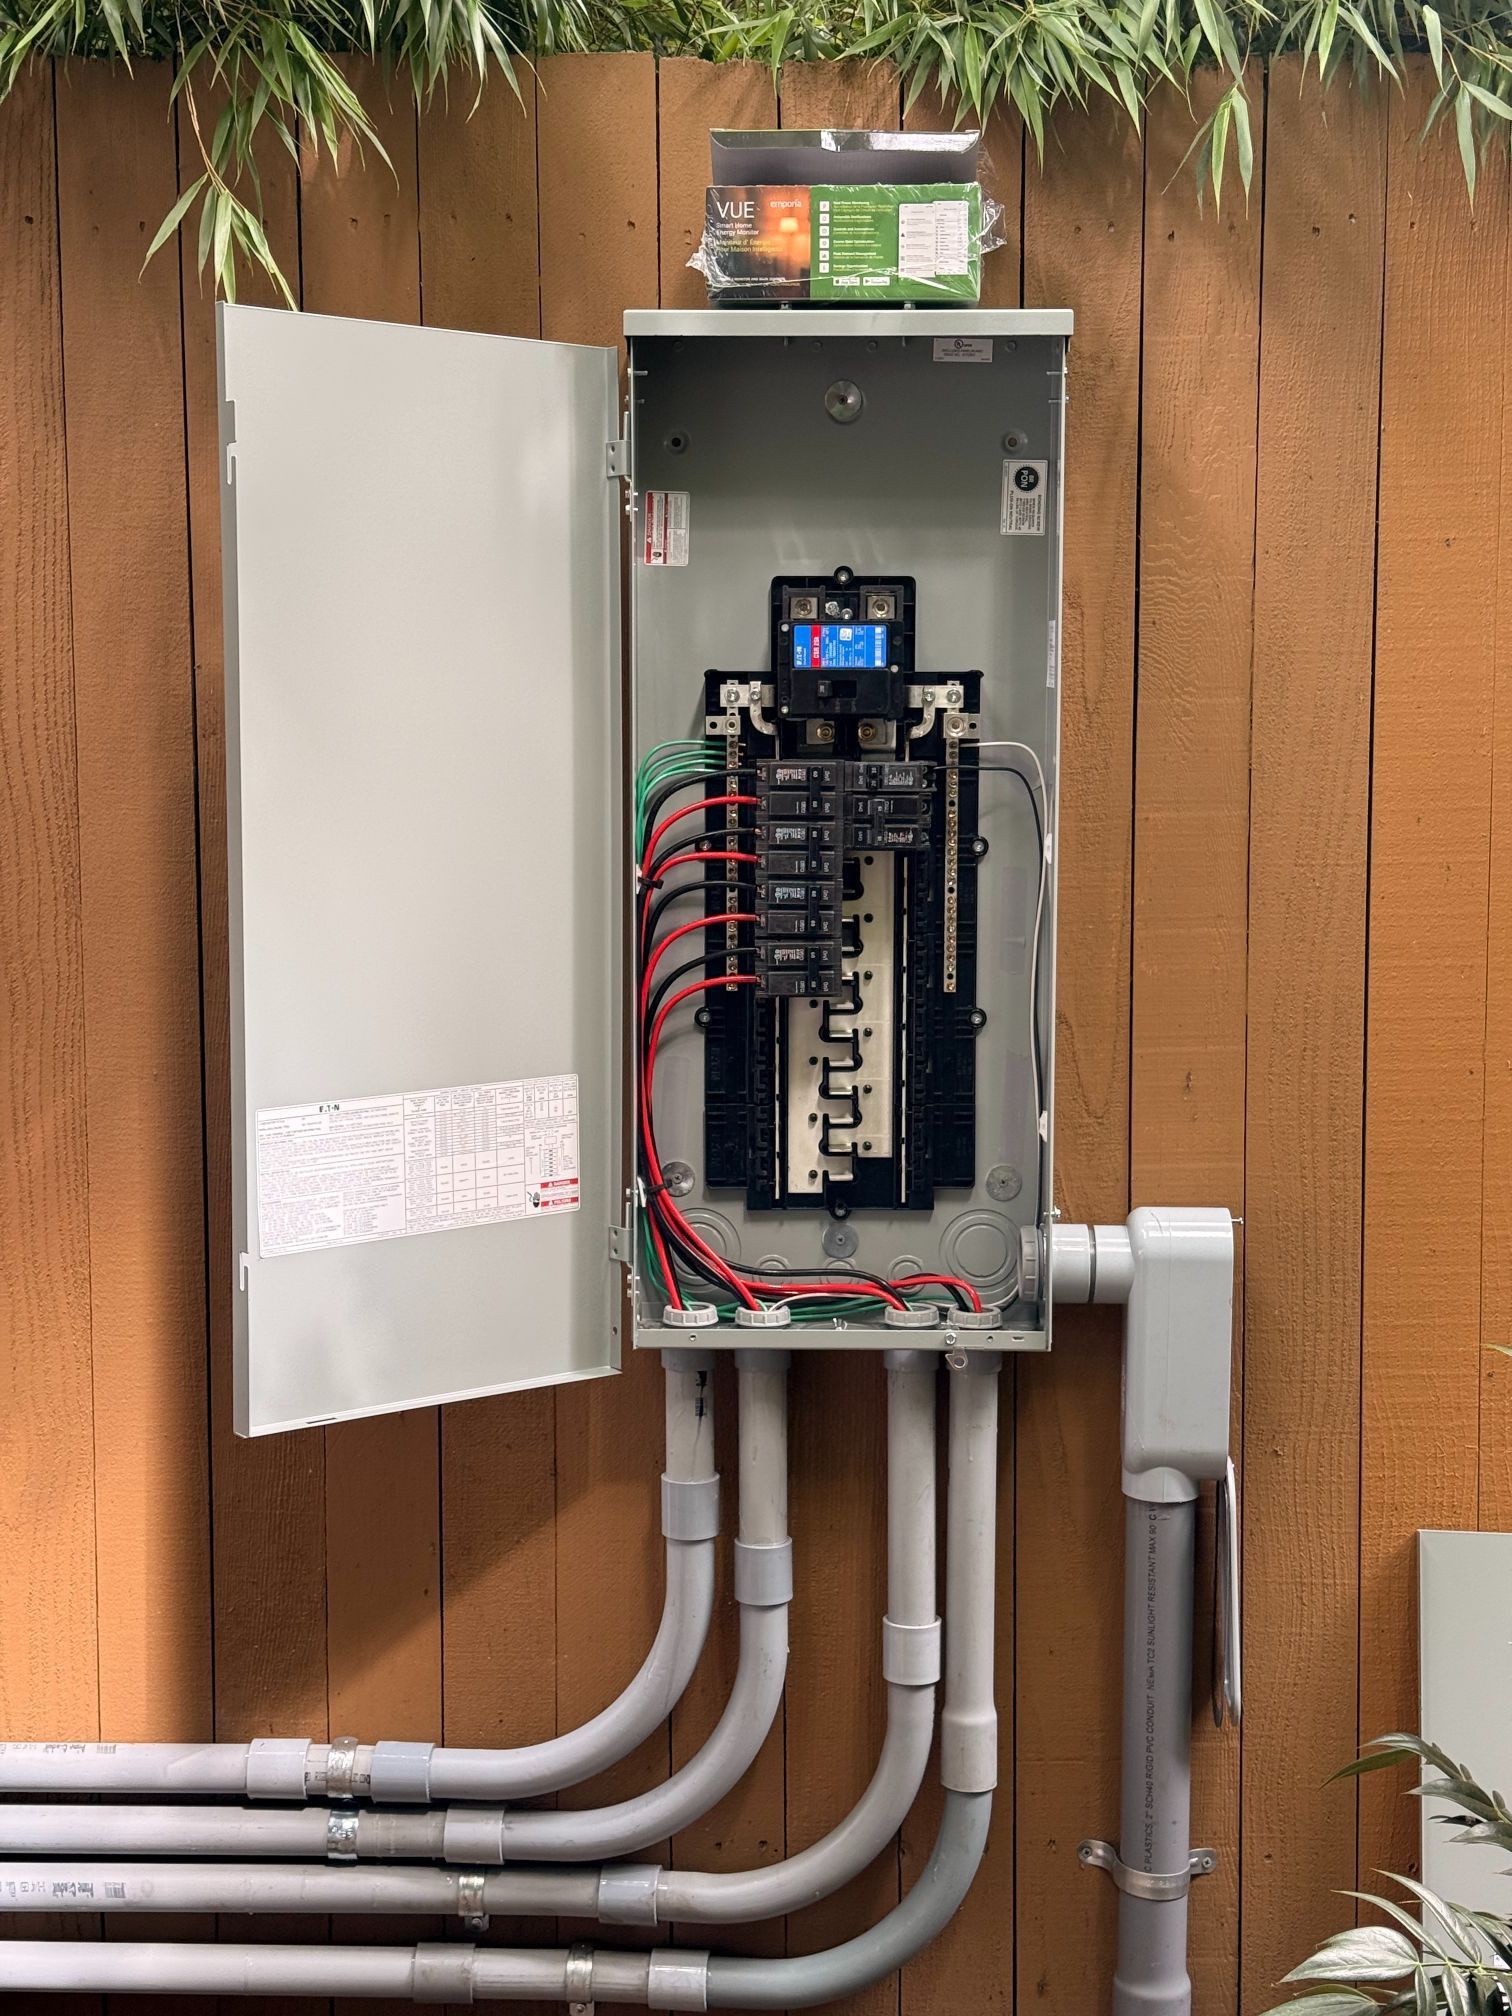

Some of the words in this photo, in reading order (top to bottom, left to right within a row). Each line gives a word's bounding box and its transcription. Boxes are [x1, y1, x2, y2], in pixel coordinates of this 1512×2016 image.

[716, 201, 755, 219] VUE
[1020, 470, 1029, 488] PON
[1149, 1524, 1157, 1535] 90
[1148, 1537, 1157, 1554] MAX
[1148, 1555, 1156, 1602] RESISTANT
[1147, 1604, 1156, 1647] SUNLIGHT
[1147, 1647, 1155, 1664] TC2
[1146, 1695, 1155, 1734] CONDUIT
[1146, 1736, 1154, 1754] PVC
[1145, 1755, 1154, 1779] RIGID
[1145, 1780, 1153, 1809] SCH40
[1144, 1823, 1153, 1865] PLASTICS
